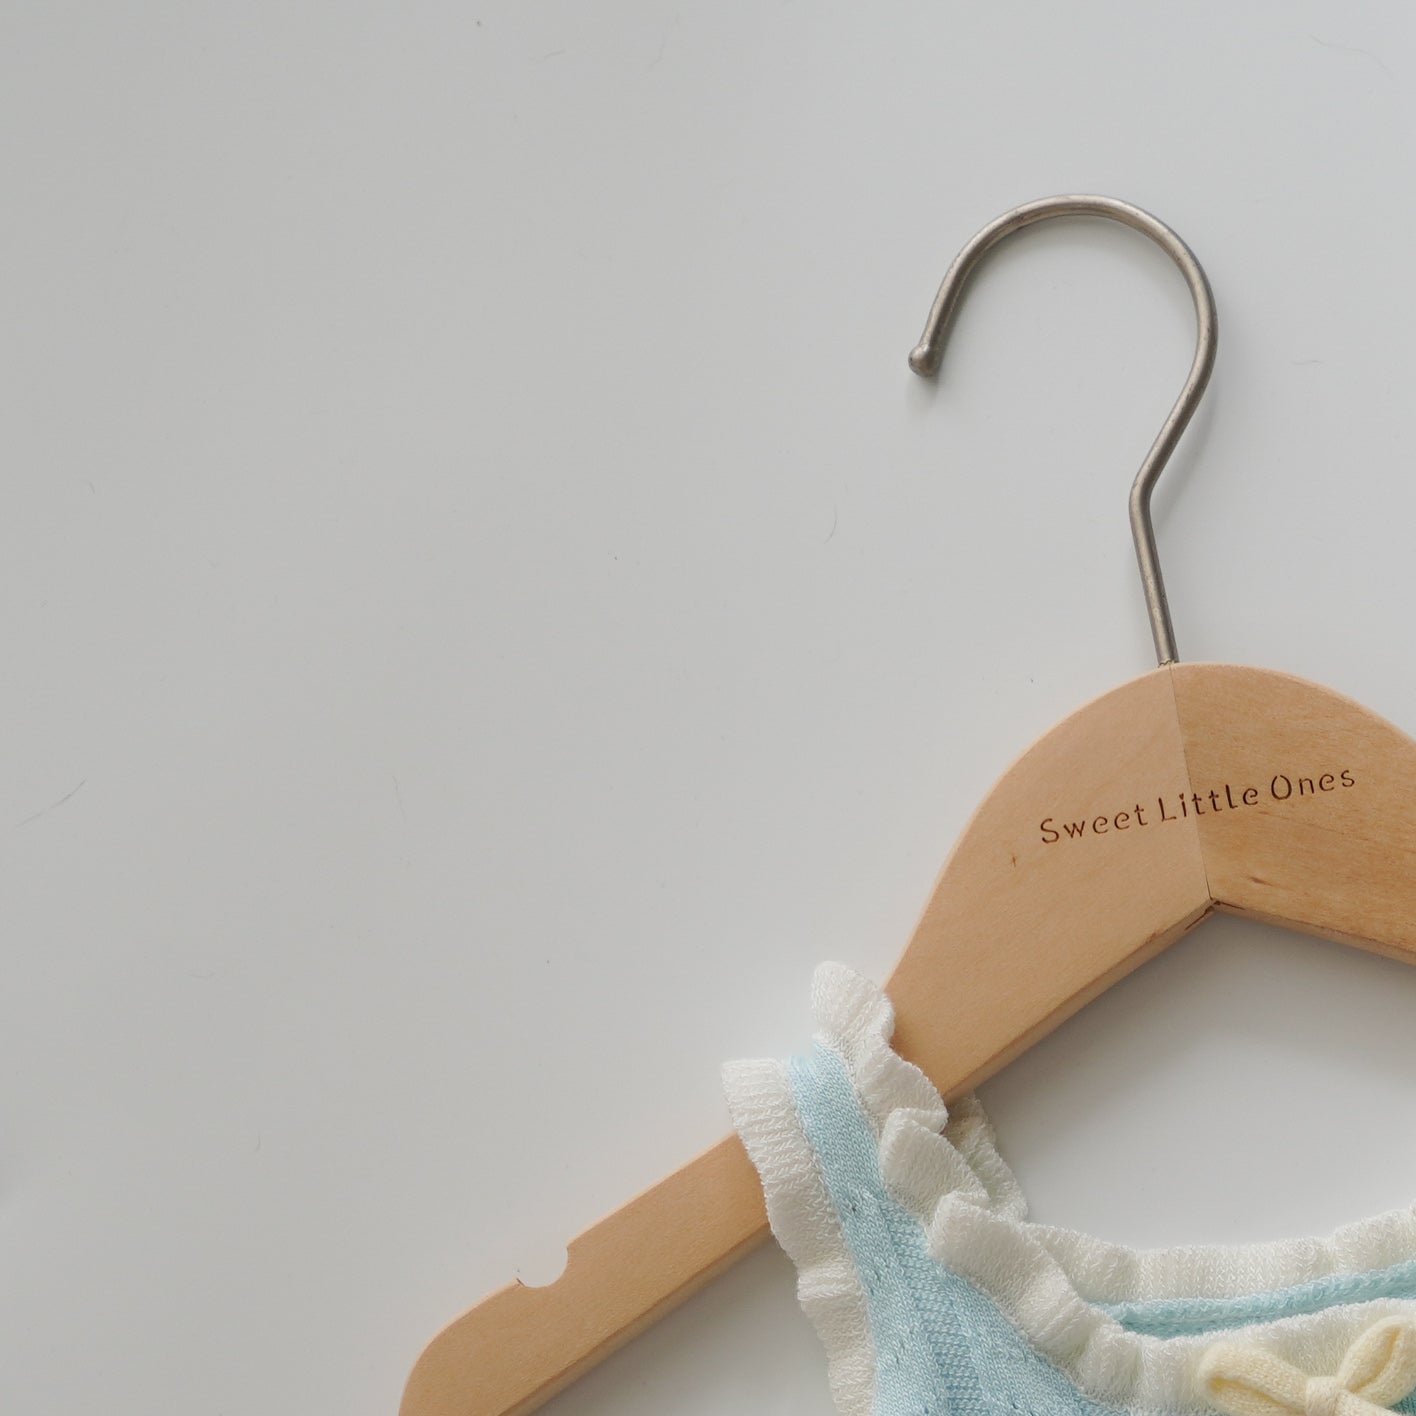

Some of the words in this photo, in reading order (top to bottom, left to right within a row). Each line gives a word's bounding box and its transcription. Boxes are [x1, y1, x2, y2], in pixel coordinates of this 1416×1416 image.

[1040, 804, 1148, 844] Sweet
[1158, 784, 1259, 822] Little
[1270, 769, 1355, 801] Ones
